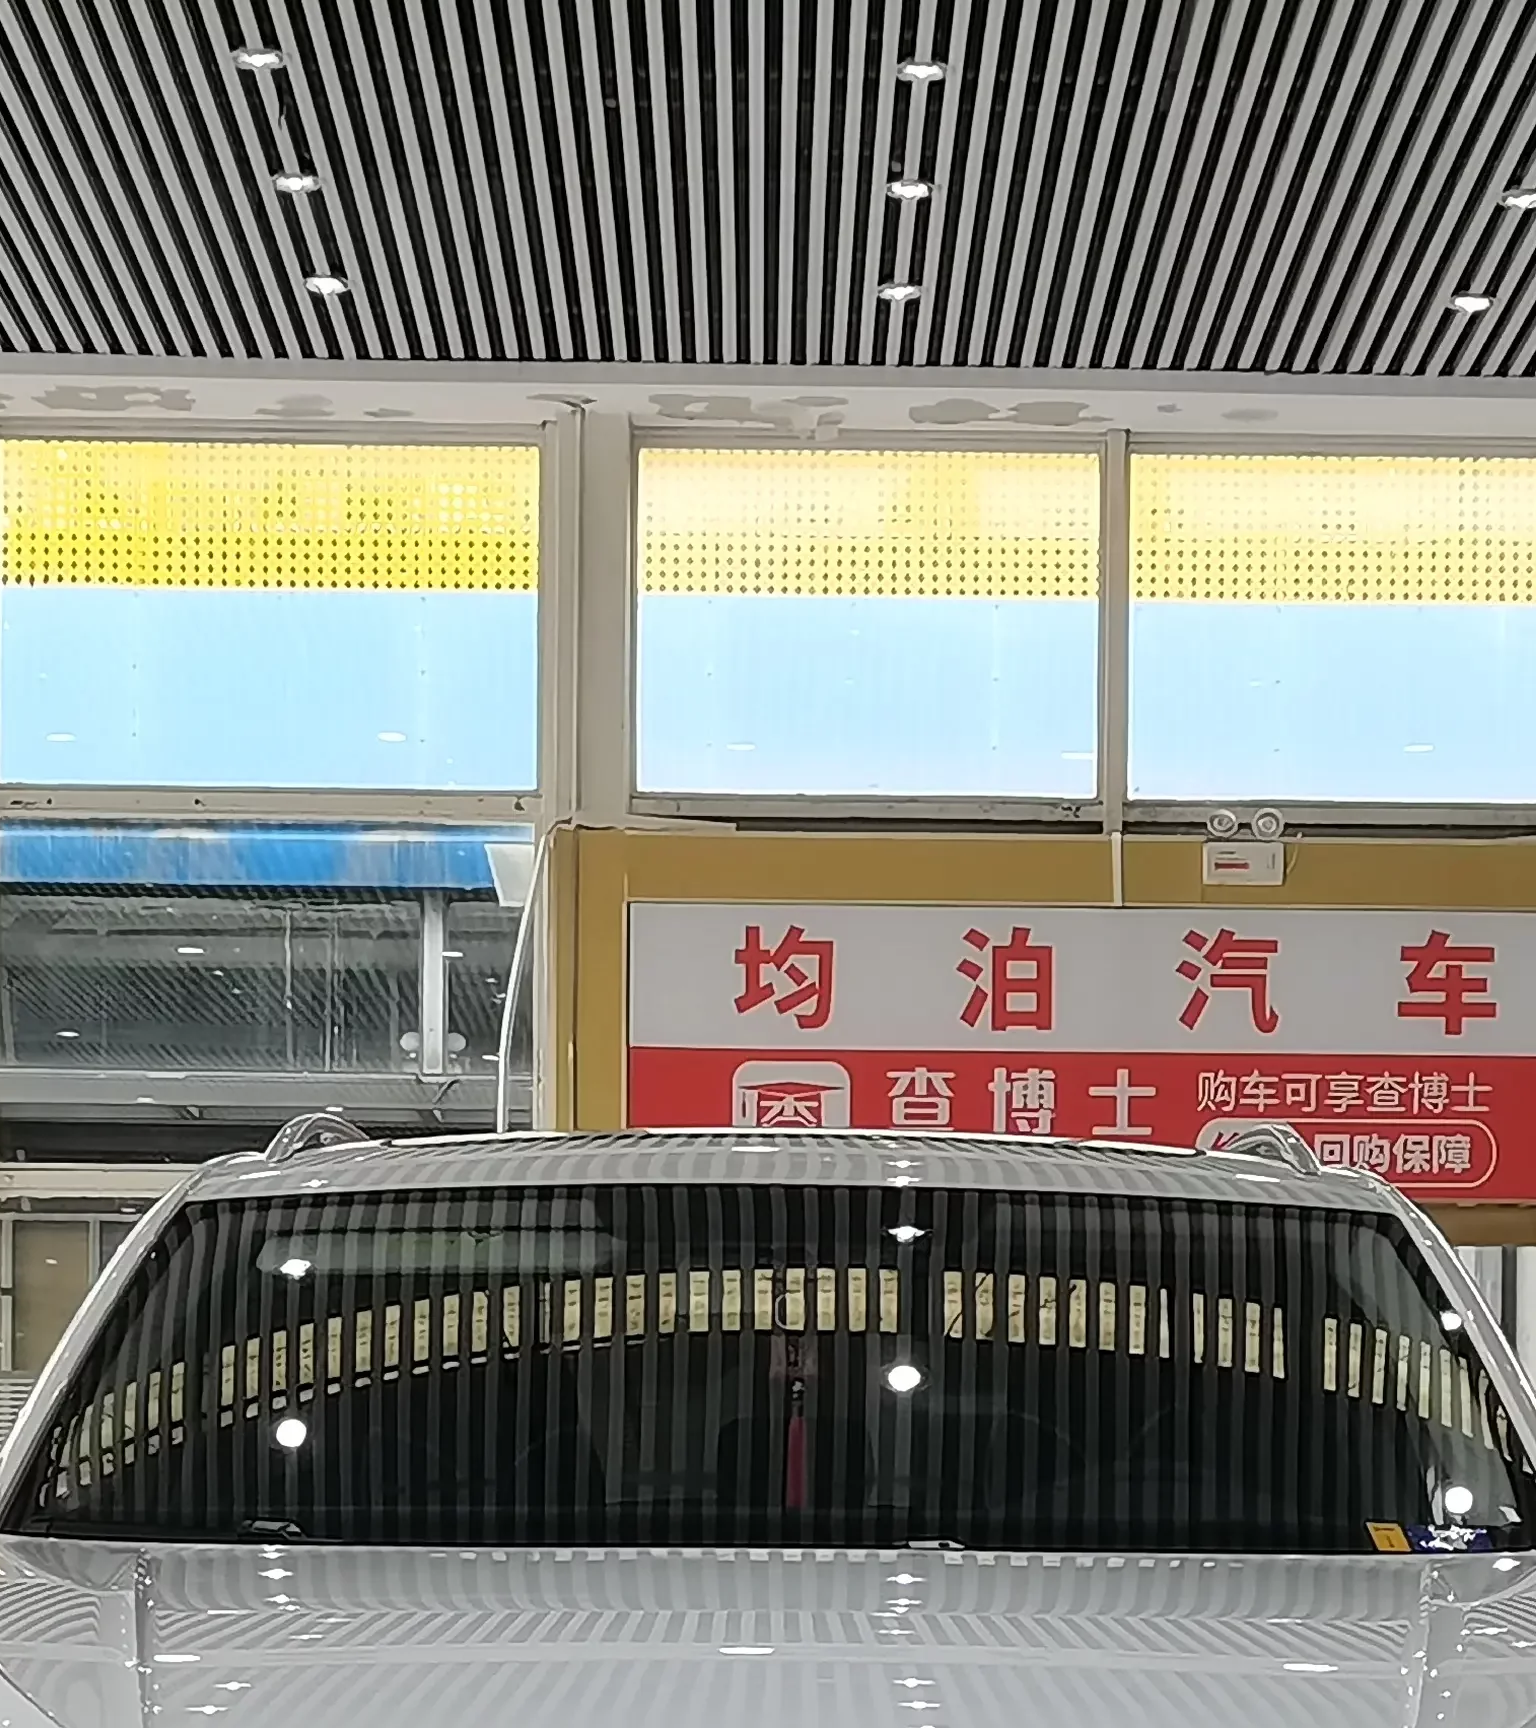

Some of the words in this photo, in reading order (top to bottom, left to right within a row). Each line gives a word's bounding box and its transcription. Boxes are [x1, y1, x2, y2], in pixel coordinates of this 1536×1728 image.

[733, 924, 1500, 1038] 均泊汽车
[886, 1066, 1157, 1136] 查博士
[1196, 1068, 1494, 1114] 购车可享查博士
